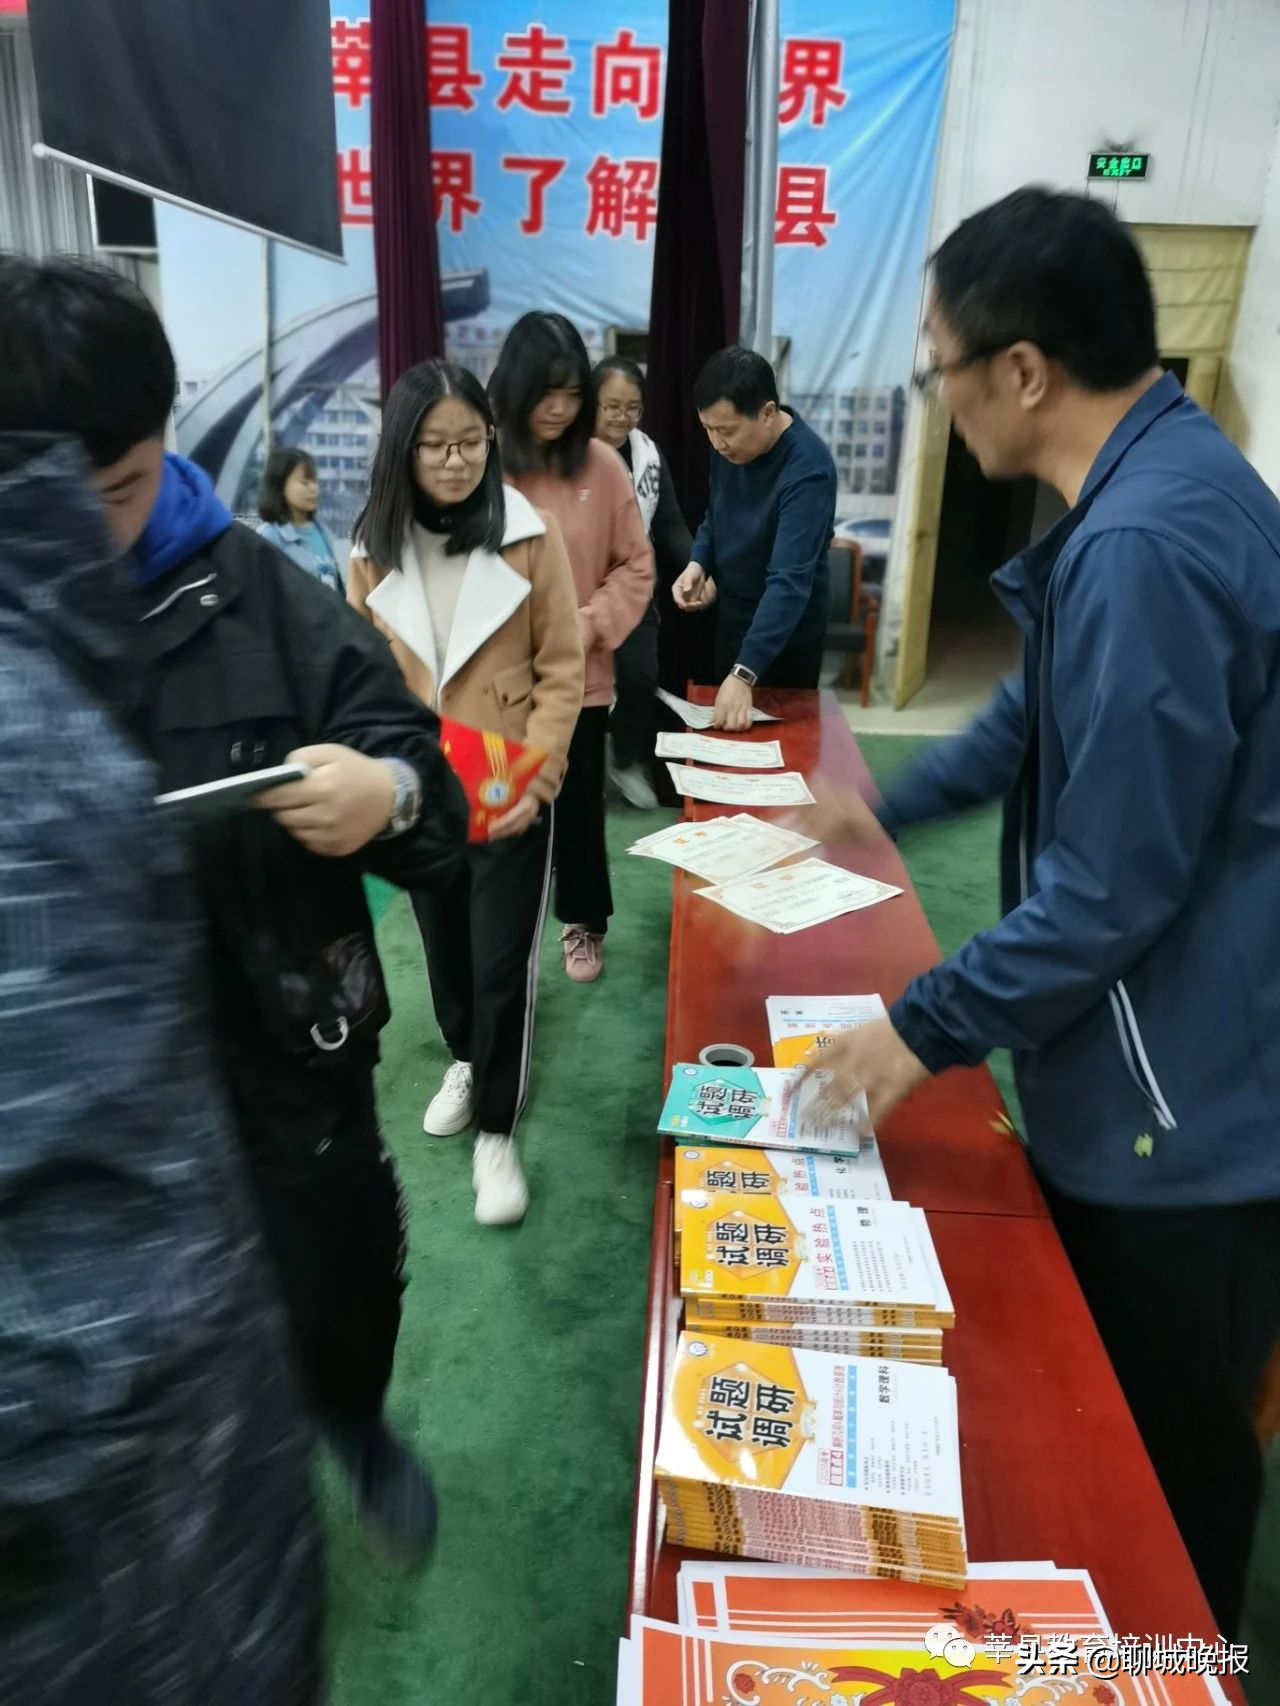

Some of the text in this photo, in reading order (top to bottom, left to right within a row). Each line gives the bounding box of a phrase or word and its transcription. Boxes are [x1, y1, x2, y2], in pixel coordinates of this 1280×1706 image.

[716, 1222, 750, 1265] 试题
[754, 1224, 790, 1267] 调研
[810, 1207, 833, 1264] 实验热点
[705, 1376, 750, 1441] 试题
[878, 1366, 891, 1404] 数学理科
[752, 1383, 796, 1448] 调研
